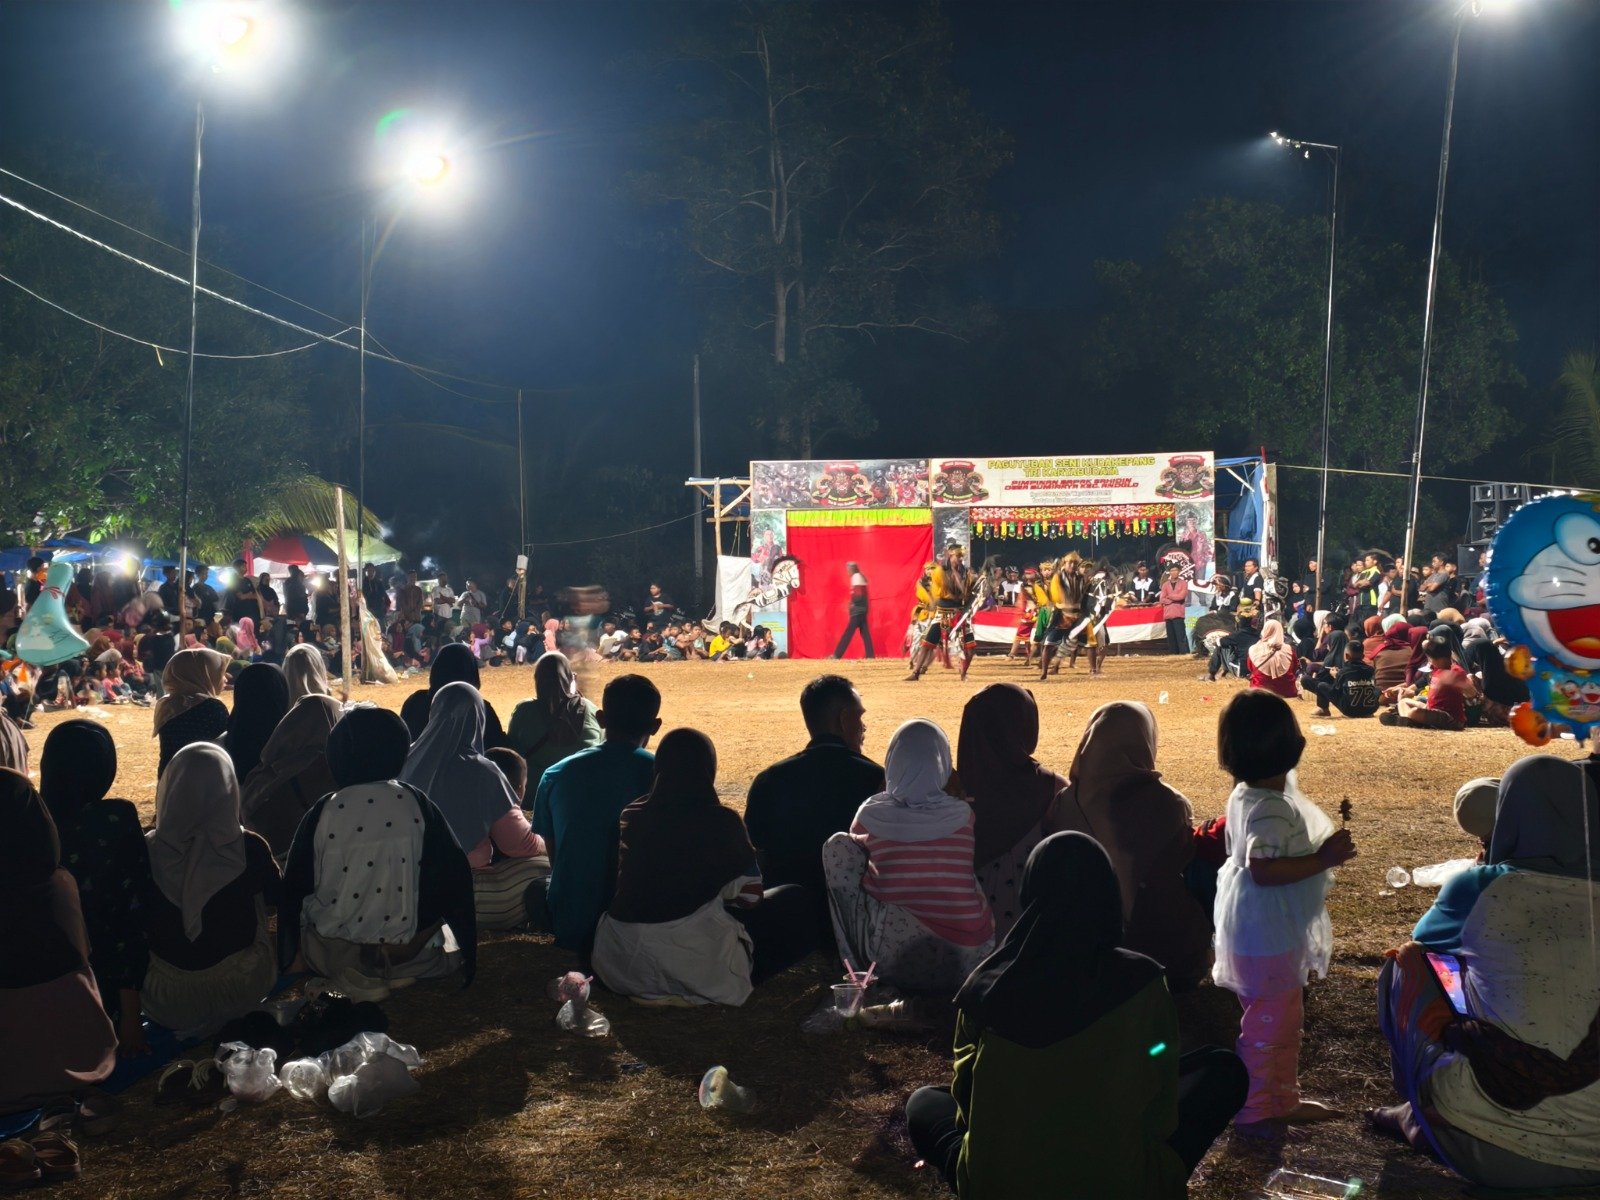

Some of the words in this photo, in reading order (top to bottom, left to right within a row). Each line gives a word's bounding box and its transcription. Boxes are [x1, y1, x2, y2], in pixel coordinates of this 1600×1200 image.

[987, 459, 1053, 469] PAGUYUBAN
[1055, 458, 1080, 468] SENI
[1081, 456, 1155, 467] KUDAKEPANG
[1023, 468, 1041, 478] TRI
[1349, 687, 1376, 707] 72
